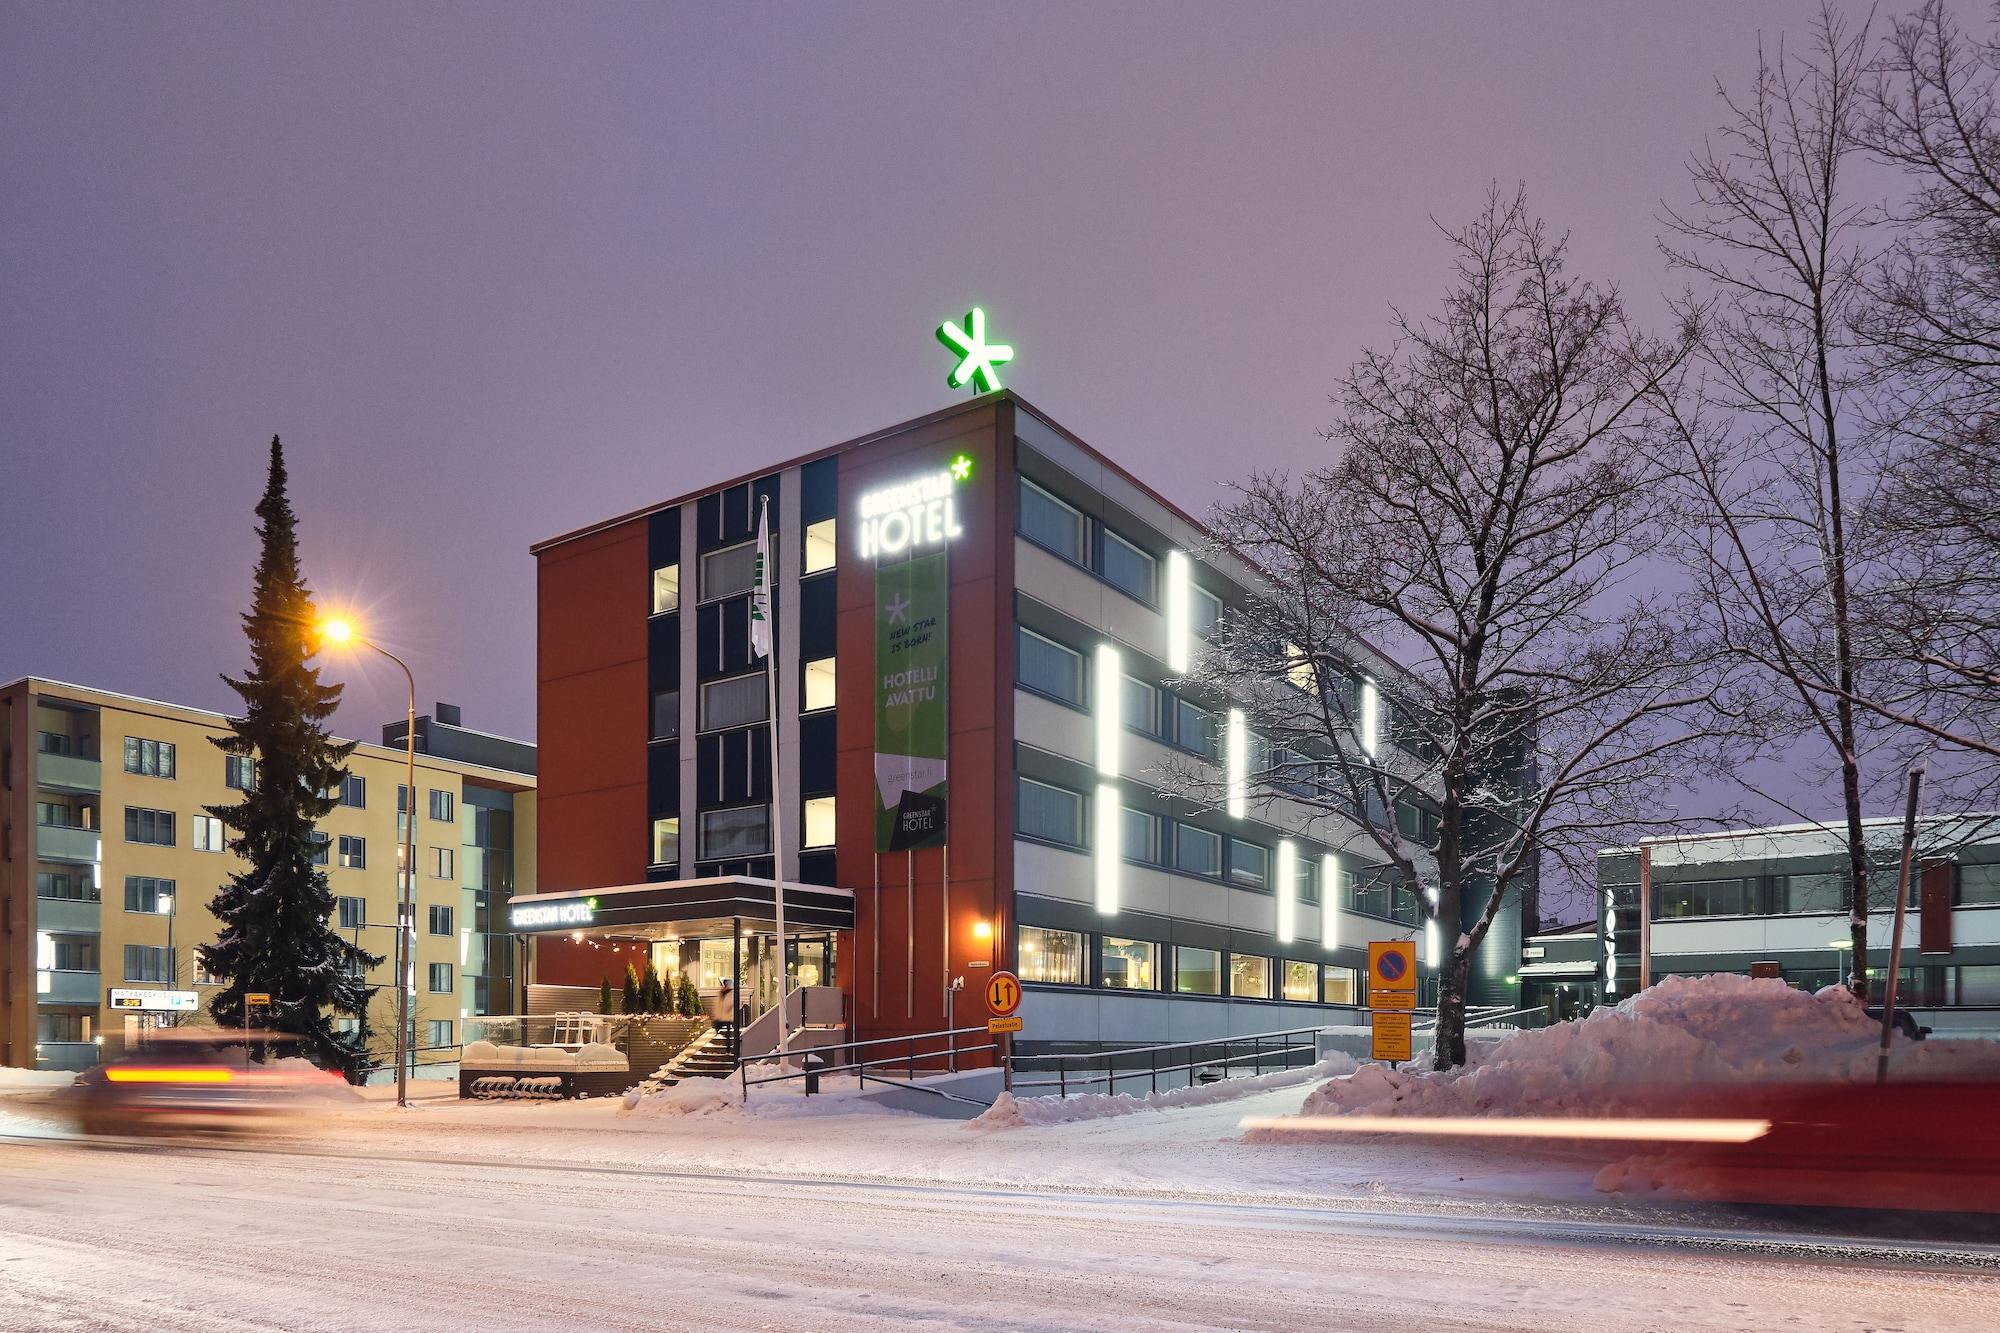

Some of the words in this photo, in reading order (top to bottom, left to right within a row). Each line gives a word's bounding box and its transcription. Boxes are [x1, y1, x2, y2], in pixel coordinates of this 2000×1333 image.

[861, 498, 961, 558] HOTEL
[889, 625, 911, 641] NEW
[913, 616, 937, 632] STAR
[890, 642, 902, 654] IS
[904, 632, 931, 649] BORN!
[884, 665, 938, 689] HOTELLI
[885, 685, 936, 709] AVATTU
[902, 817, 934, 831] HOTEL
[903, 809, 931, 820] GREENSTAR
[513, 907, 558, 926] GREENSTAR
[559, 904, 593, 922] HOTEL
